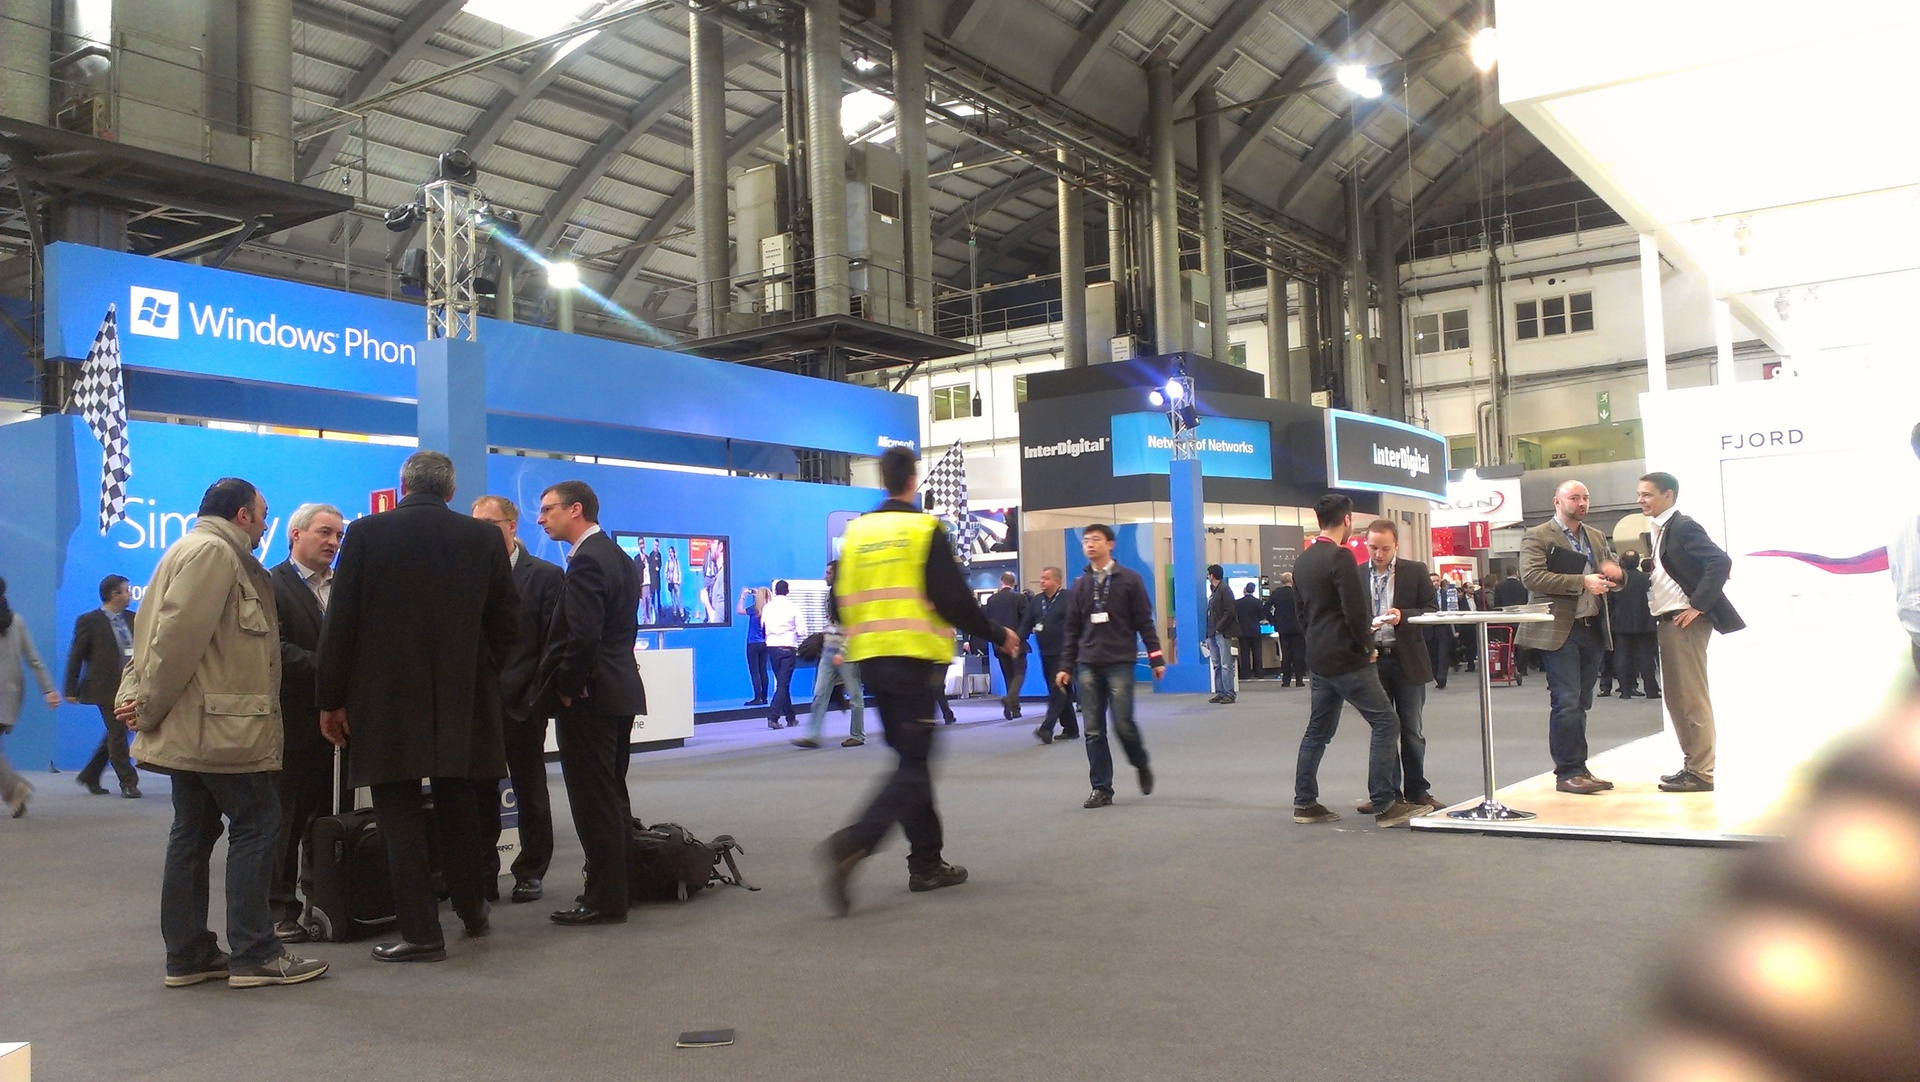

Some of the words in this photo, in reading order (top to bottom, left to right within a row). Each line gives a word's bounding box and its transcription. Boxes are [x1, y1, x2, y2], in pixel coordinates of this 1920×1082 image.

[189, 302, 336, 355] Windows
[345, 327, 416, 366] Phon
[1024, 437, 1105, 459] InterDigital
[1196, 438, 1207, 451] of
[1208, 438, 1254, 454] Networks
[1721, 429, 1804, 450] FJORD
[1373, 442, 1430, 478] InterDigital
[118, 497, 279, 563] Simy
